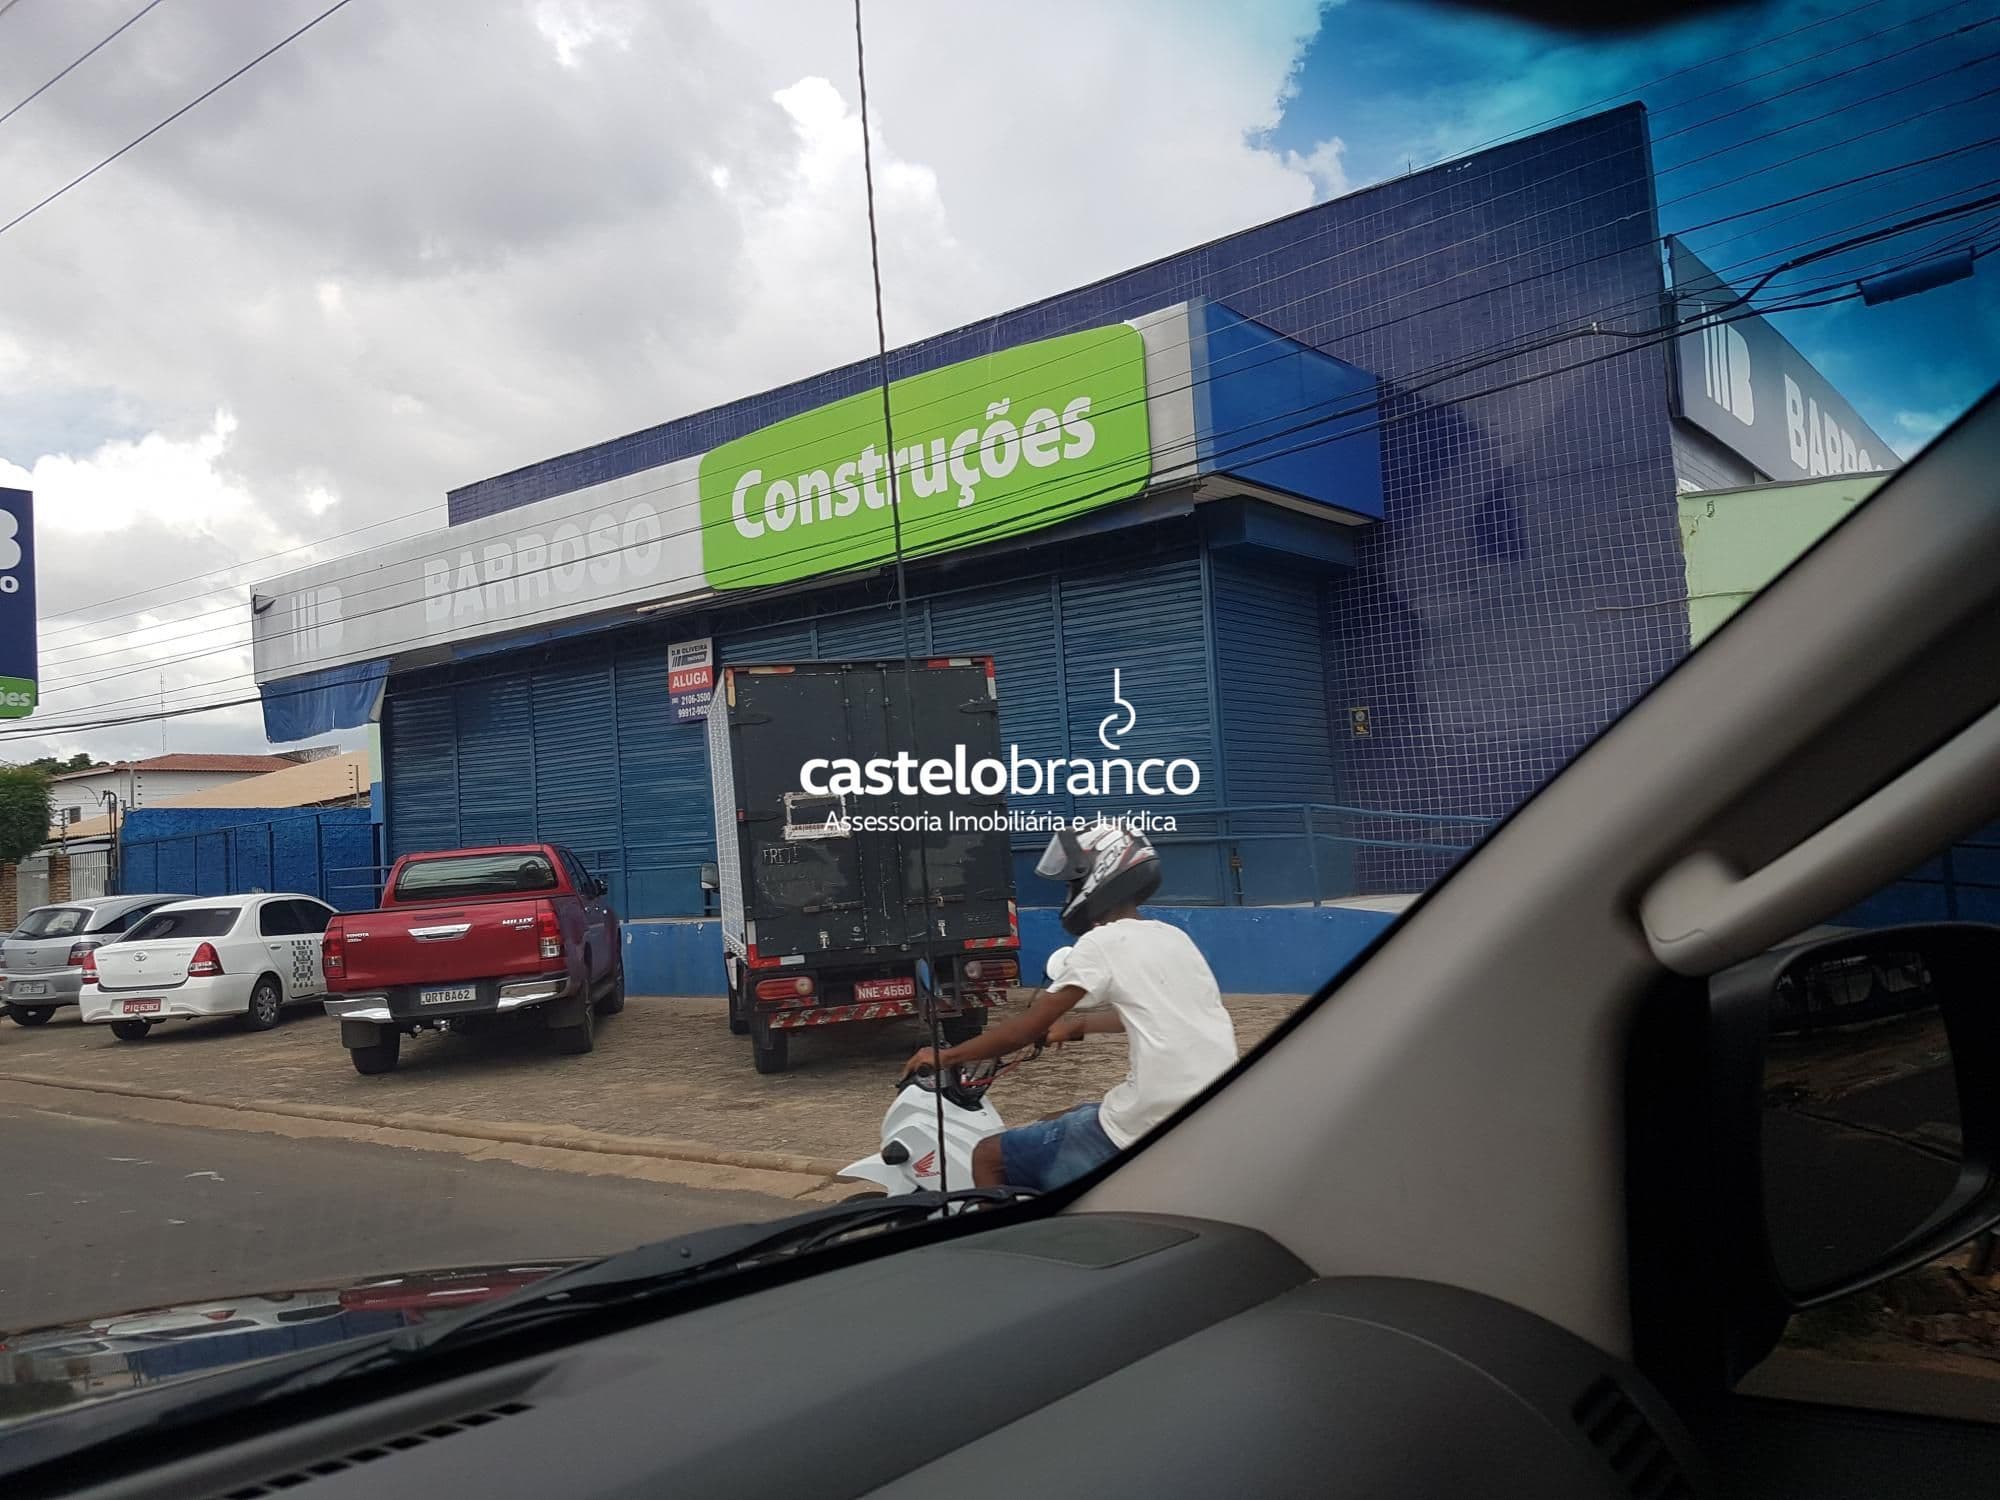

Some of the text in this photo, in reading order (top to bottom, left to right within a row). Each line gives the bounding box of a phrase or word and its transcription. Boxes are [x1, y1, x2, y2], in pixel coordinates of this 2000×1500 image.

[731, 396, 1097, 540] Construções
[424, 502, 663, 623] BARROSO
[672, 671, 708, 688] ALUGA
